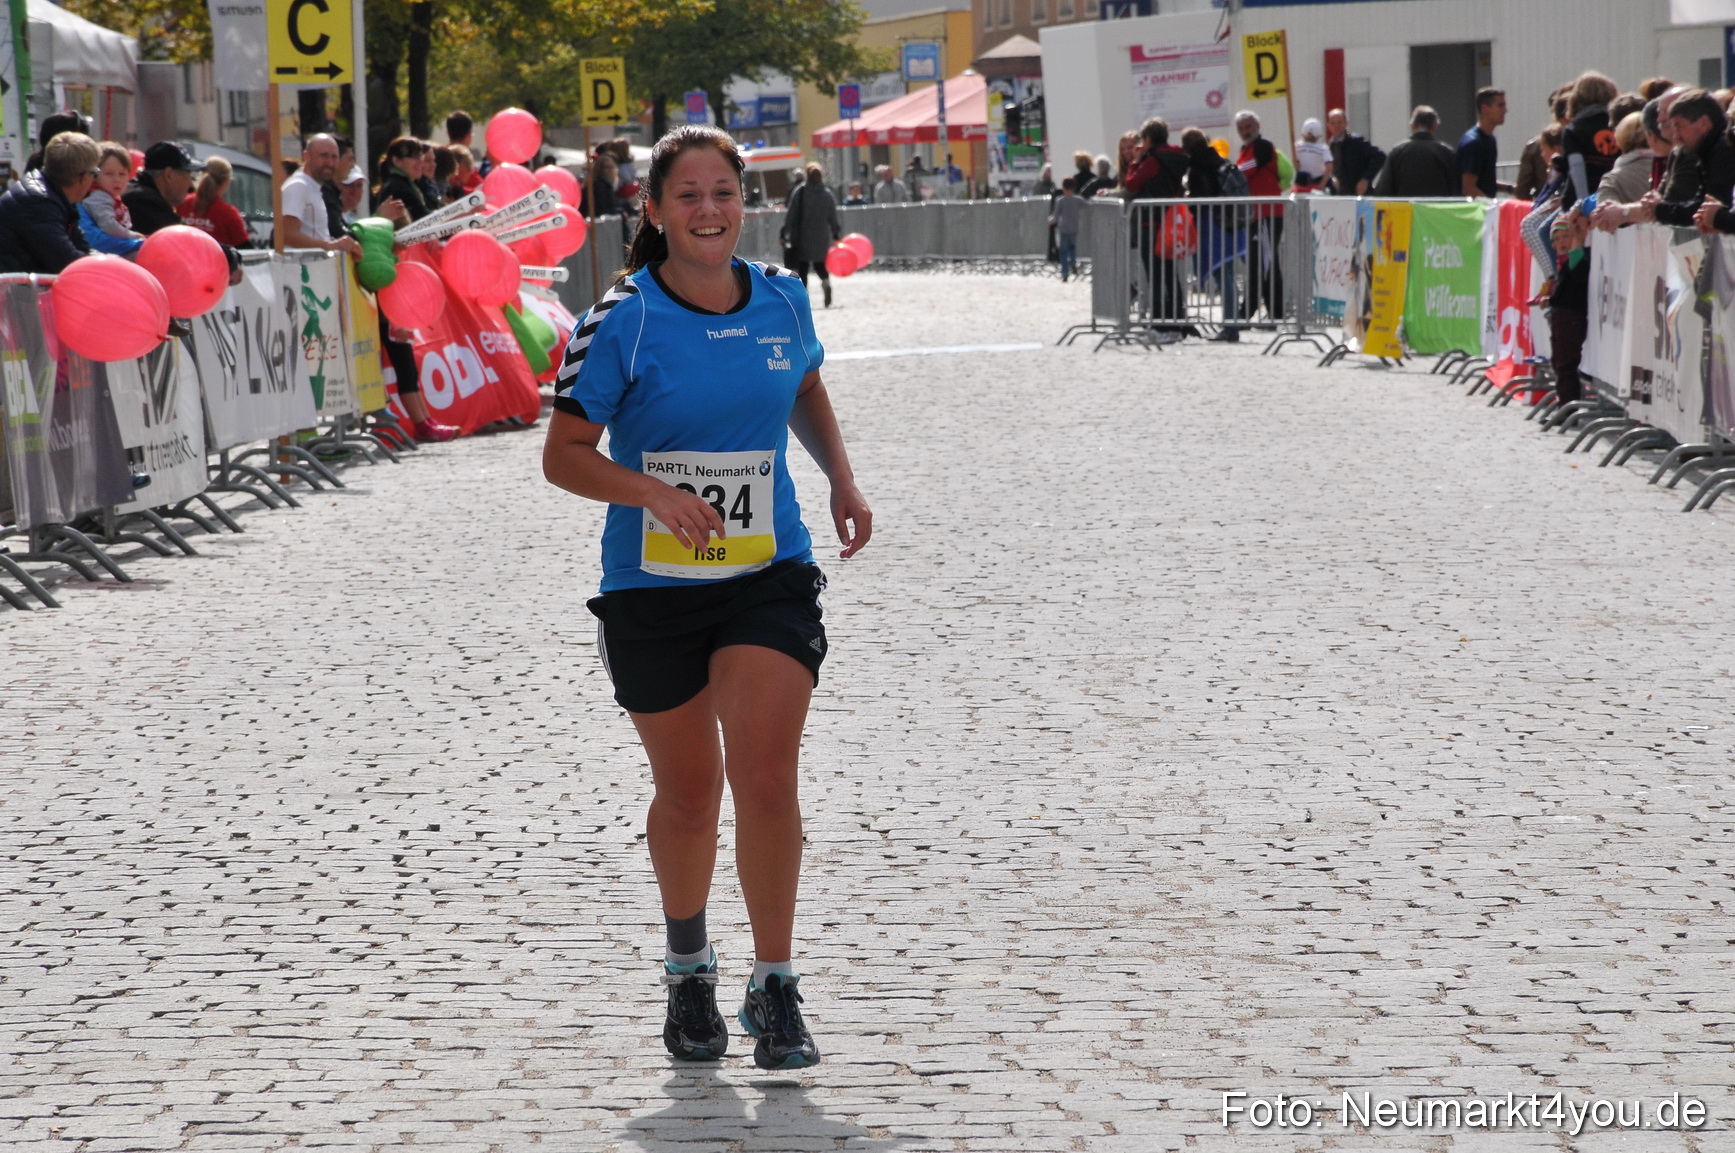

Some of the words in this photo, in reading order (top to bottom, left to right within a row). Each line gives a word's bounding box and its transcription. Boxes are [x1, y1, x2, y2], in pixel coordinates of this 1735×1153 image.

[287, 0, 331, 56] C
[1247, 33, 1281, 48] Block
[585, 62, 619, 74] Block
[1255, 52, 1278, 84] D
[592, 79, 615, 110] D
[523, 268, 547, 277] BMW
[706, 325, 748, 340] hummel
[647, 462, 692, 476] PARTL
[695, 465, 755, 477] Neumarkt
[674, 482, 753, 529] 34
